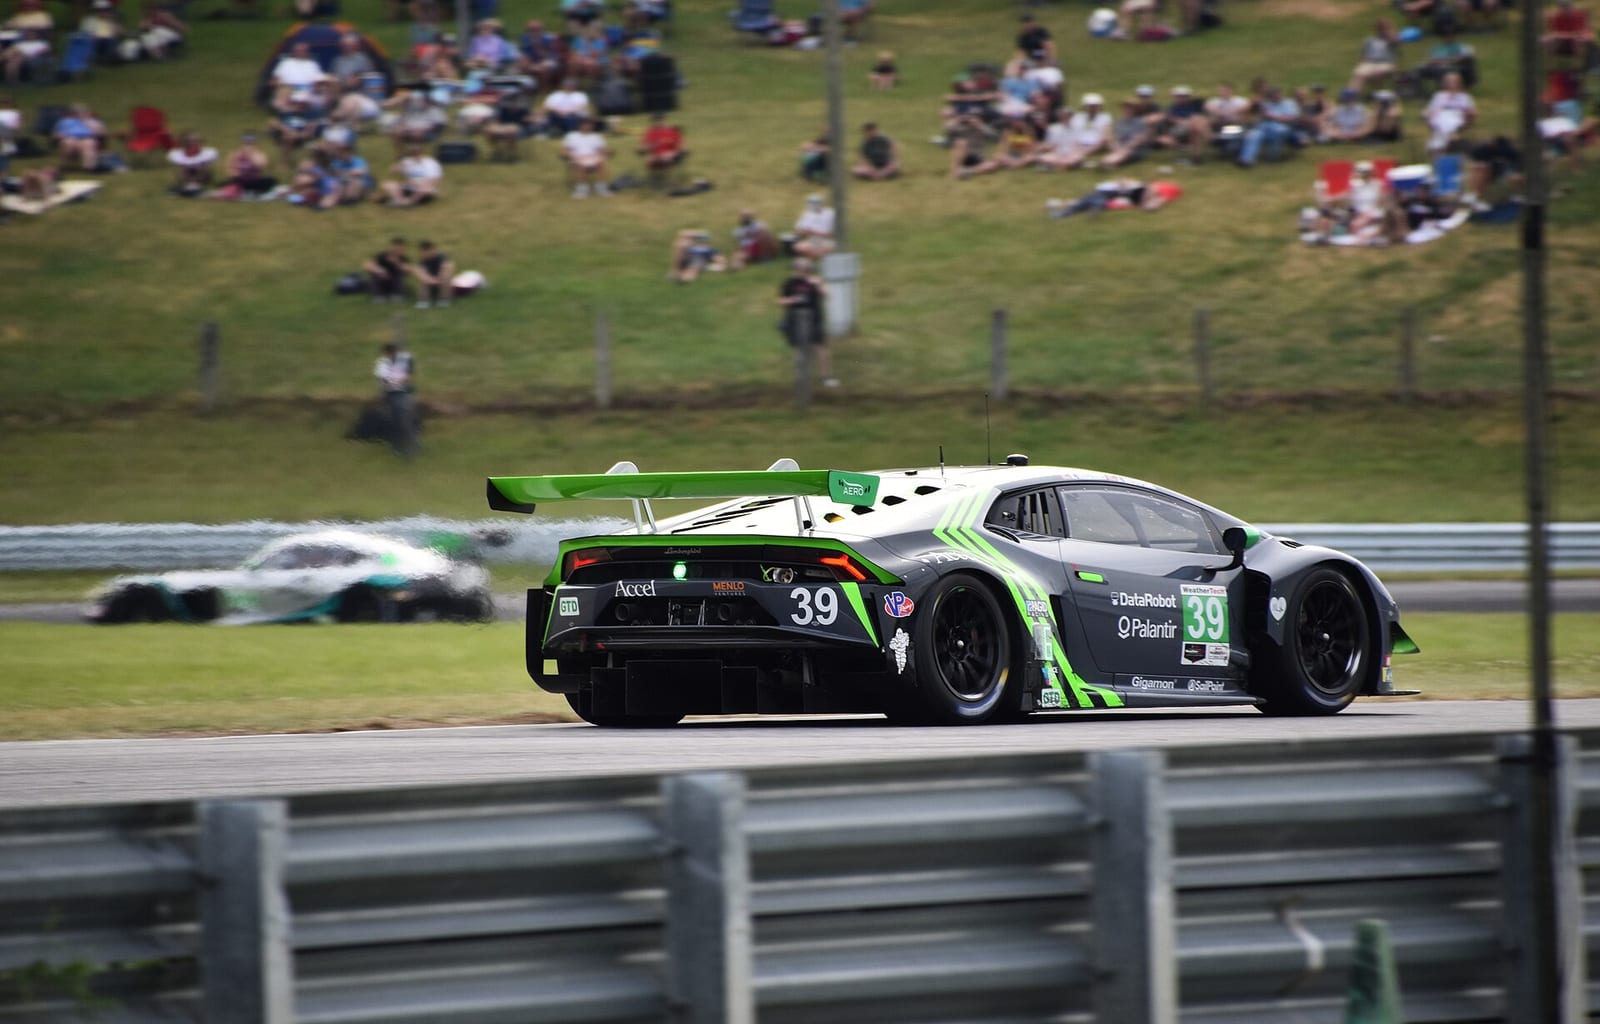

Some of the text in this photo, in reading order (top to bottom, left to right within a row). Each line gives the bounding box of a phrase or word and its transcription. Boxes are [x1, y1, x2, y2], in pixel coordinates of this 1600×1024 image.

[842, 486, 864, 496] AERO
[615, 580, 657, 597] Accel
[712, 581, 745, 591] MENLO
[560, 600, 578, 613] GTD
[790, 587, 839, 625] 39
[884, 591, 905, 617] VP
[1119, 592, 1177, 608] DataRobot
[1187, 595, 1225, 640] 39
[1131, 618, 1177, 639] Palantir
[1131, 676, 1175, 690] Gigamon
